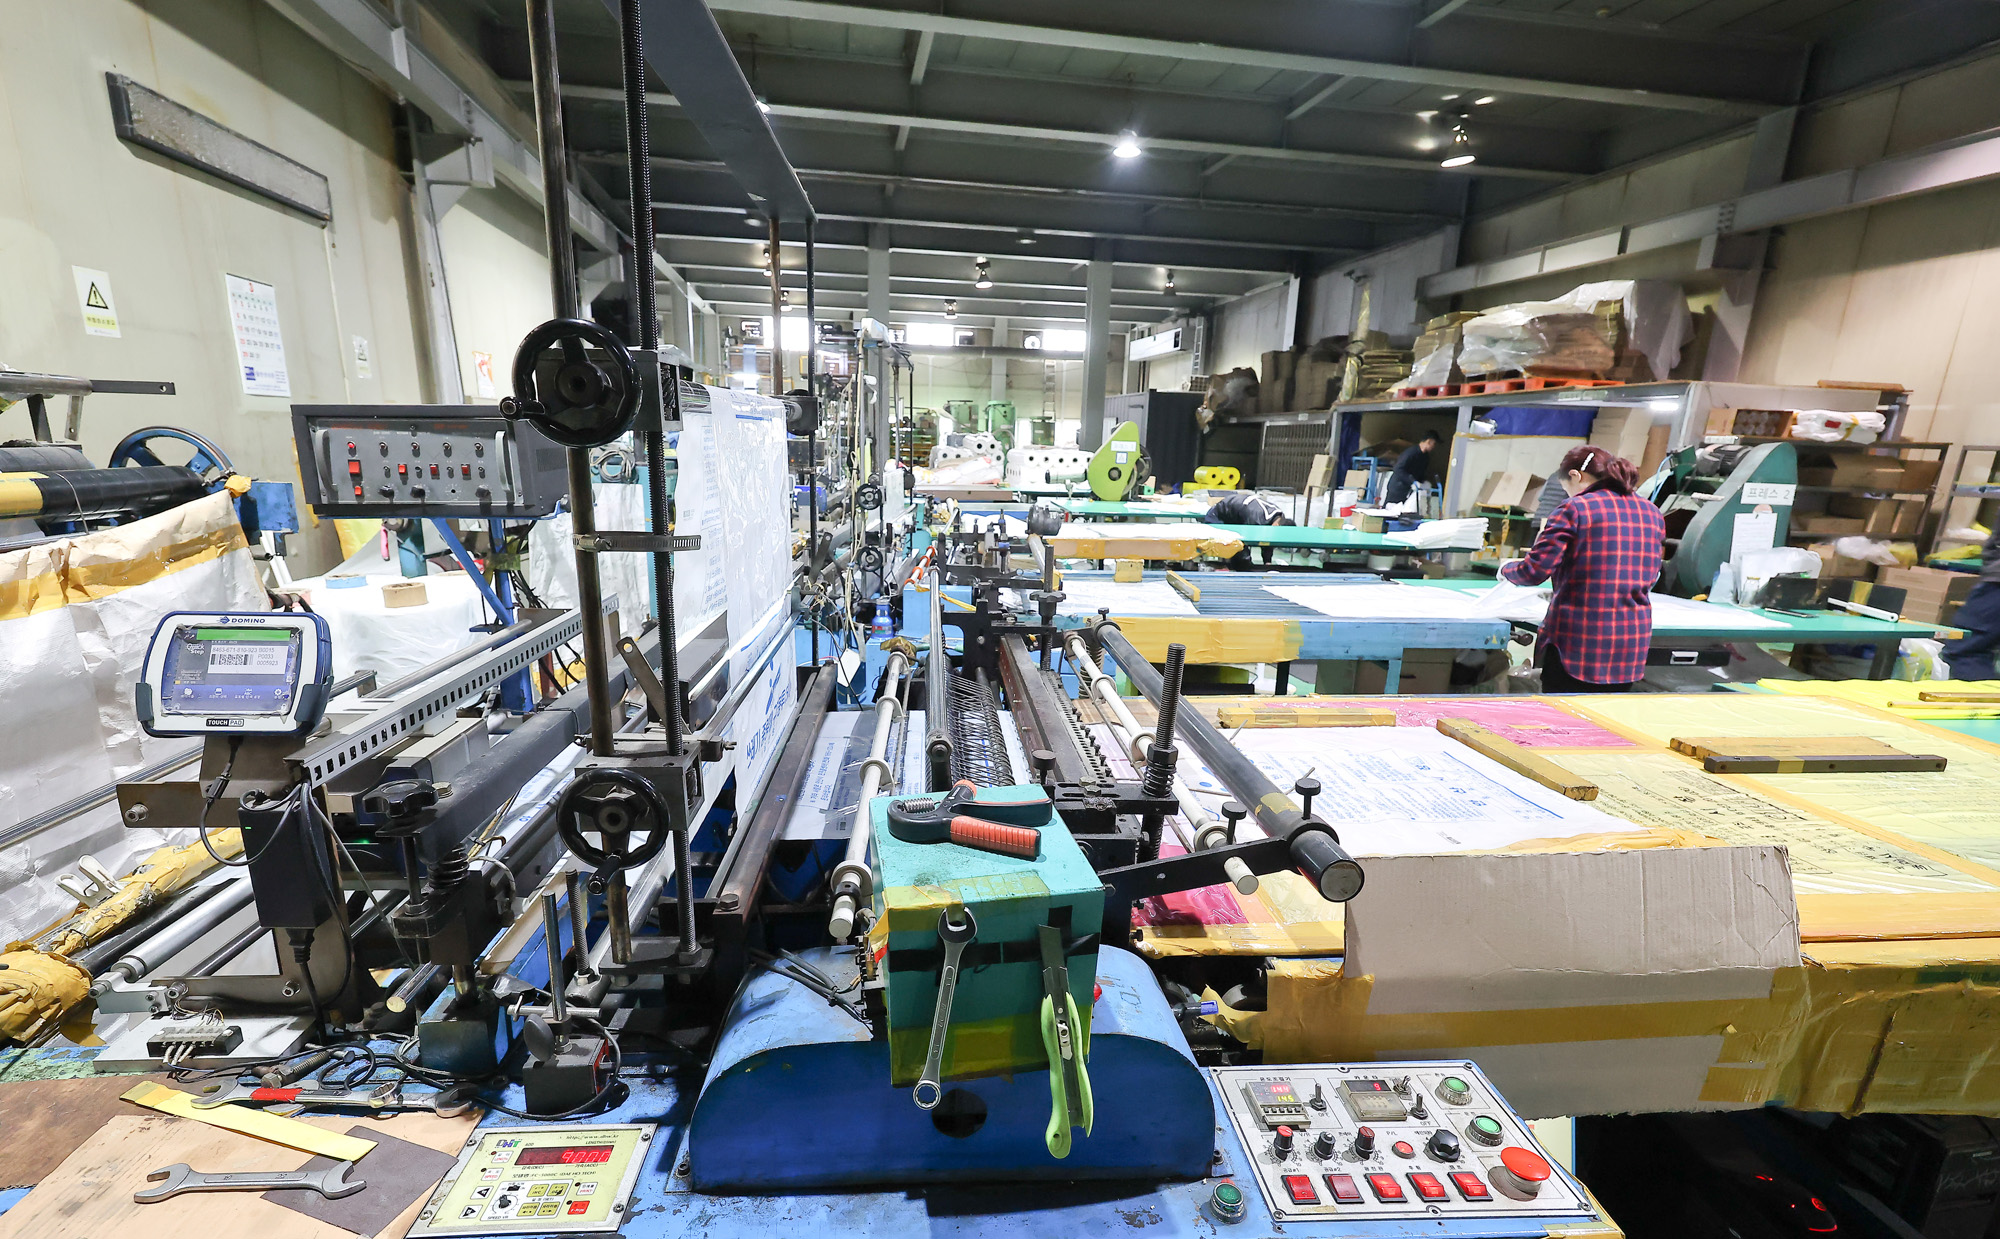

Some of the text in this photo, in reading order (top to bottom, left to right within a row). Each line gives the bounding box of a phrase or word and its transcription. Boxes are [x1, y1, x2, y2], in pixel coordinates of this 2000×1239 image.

[1747, 487, 1790, 499] 프레스 2
[1272, 1085, 1290, 1093] 144
[1373, 1082, 1381, 1091] 9
